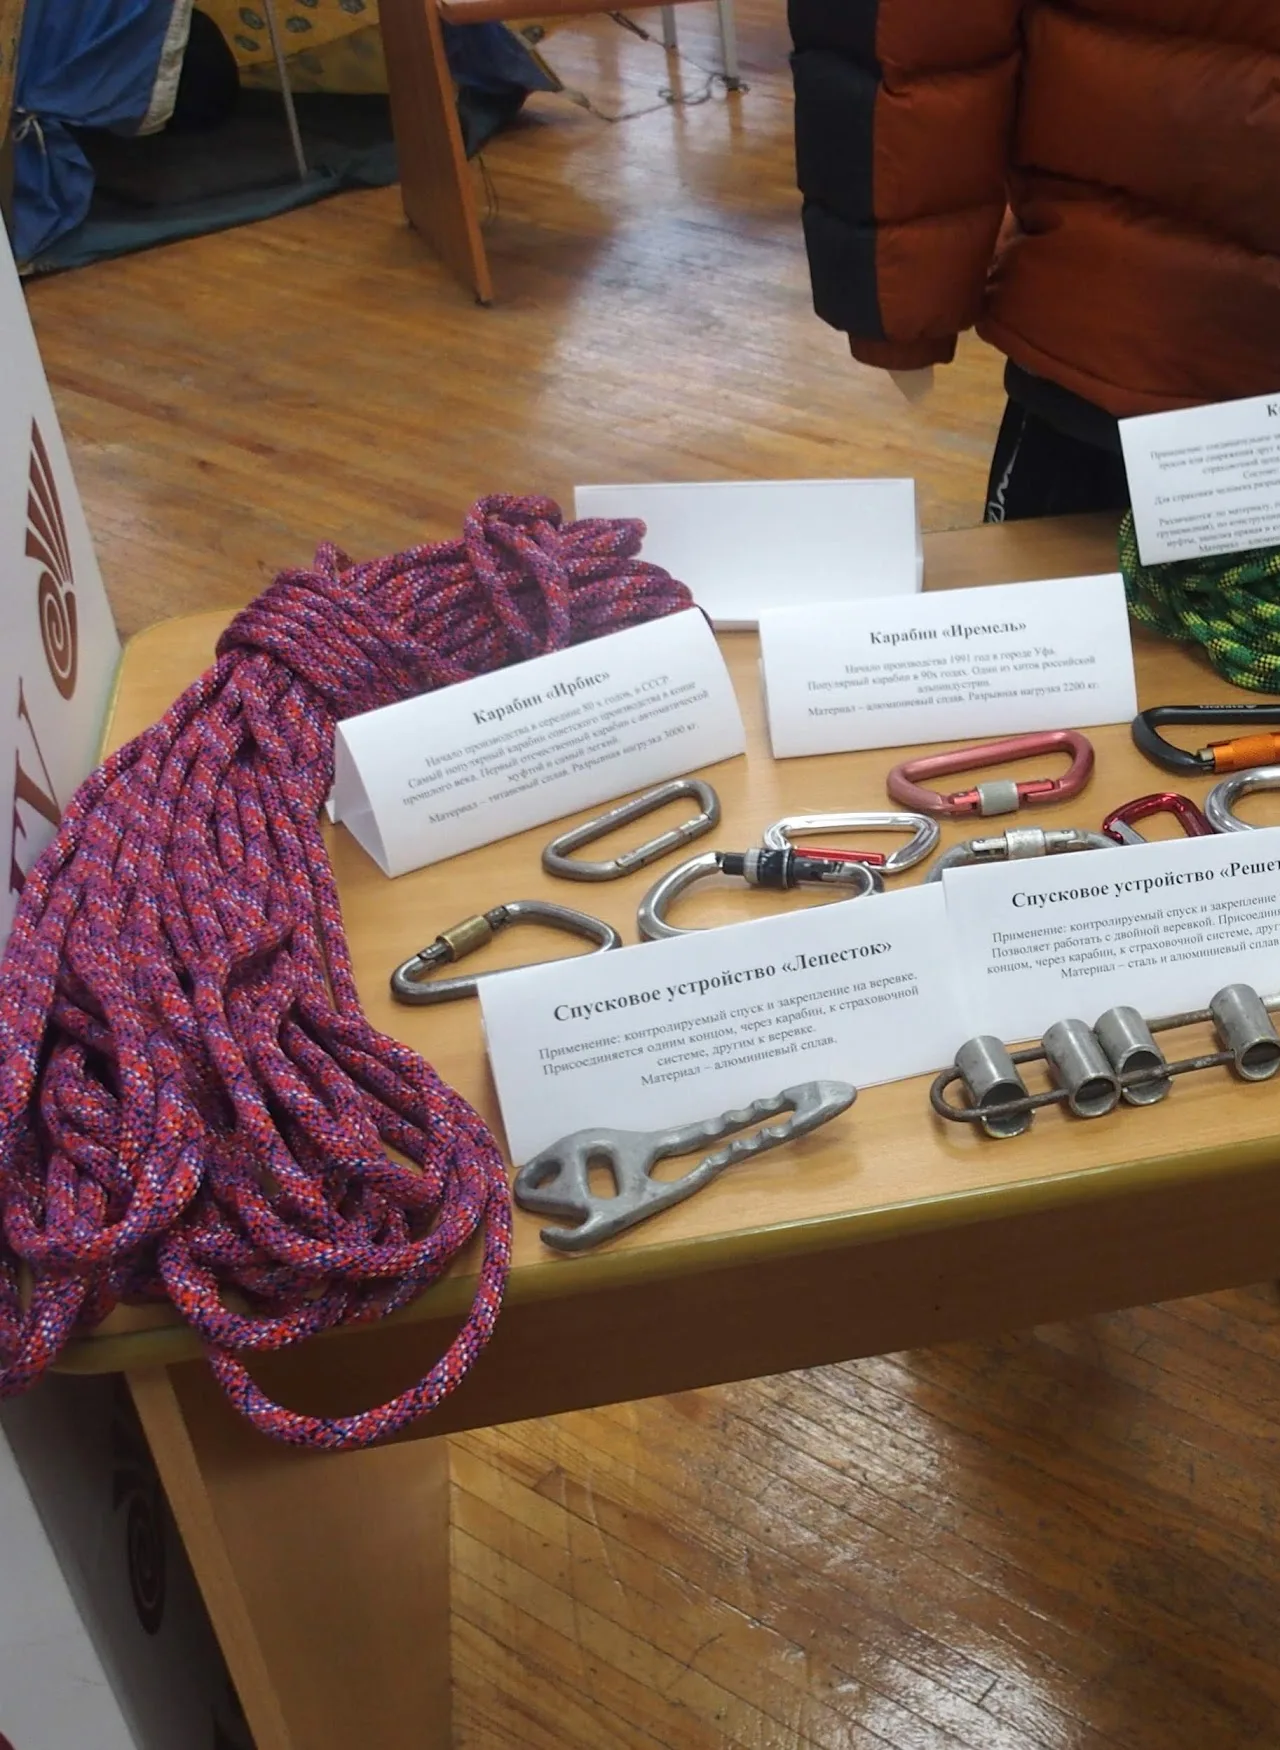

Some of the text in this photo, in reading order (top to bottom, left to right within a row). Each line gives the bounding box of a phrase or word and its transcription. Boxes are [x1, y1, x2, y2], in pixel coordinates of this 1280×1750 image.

[869, 622, 1026, 646] Карабин «Иремель»
[471, 673, 610, 724] Карабин «Ирбис»
[1011, 885, 1109, 908] Спусковое
[1113, 870, 1214, 896] устройство
[1069, 909, 1164, 931] контролируемый
[1166, 906, 1198, 918] спуск
[1210, 895, 1276, 910] закрепление
[991, 943, 1049, 958] Позволяет
[1053, 936, 1102, 952] работать
[1113, 924, 1160, 942] двойной
[1034, 956, 1065, 967] через
[1128, 933, 1204, 953] страховочной
[1060, 963, 1115, 978] Материал
[1127, 957, 1157, 967] сталь
[1160, 955, 1167, 963] и
[1170, 941, 1246, 961] алюминиевый
[553, 943, 892, 1019] Спусковое устройство «Лепесток»
[542, 1047, 645, 1074] Присоединяется
[647, 1038, 686, 1053] одним
[739, 1019, 772, 1032] через
[829, 1004, 837, 1012] к
[839, 985, 919, 1010] страховочной
[624, 1010, 728, 1040] контролируемый
[730, 1004, 765, 1018] спуск
[766, 1002, 775, 1010] и
[777, 987, 850, 1007] закрепление
[852, 982, 867, 992] на
[640, 1067, 701, 1085] Материал
[714, 1043, 798, 1068] алюминиевый
[712, 1038, 755, 1056] другим
[757, 1035, 766, 1044] к
